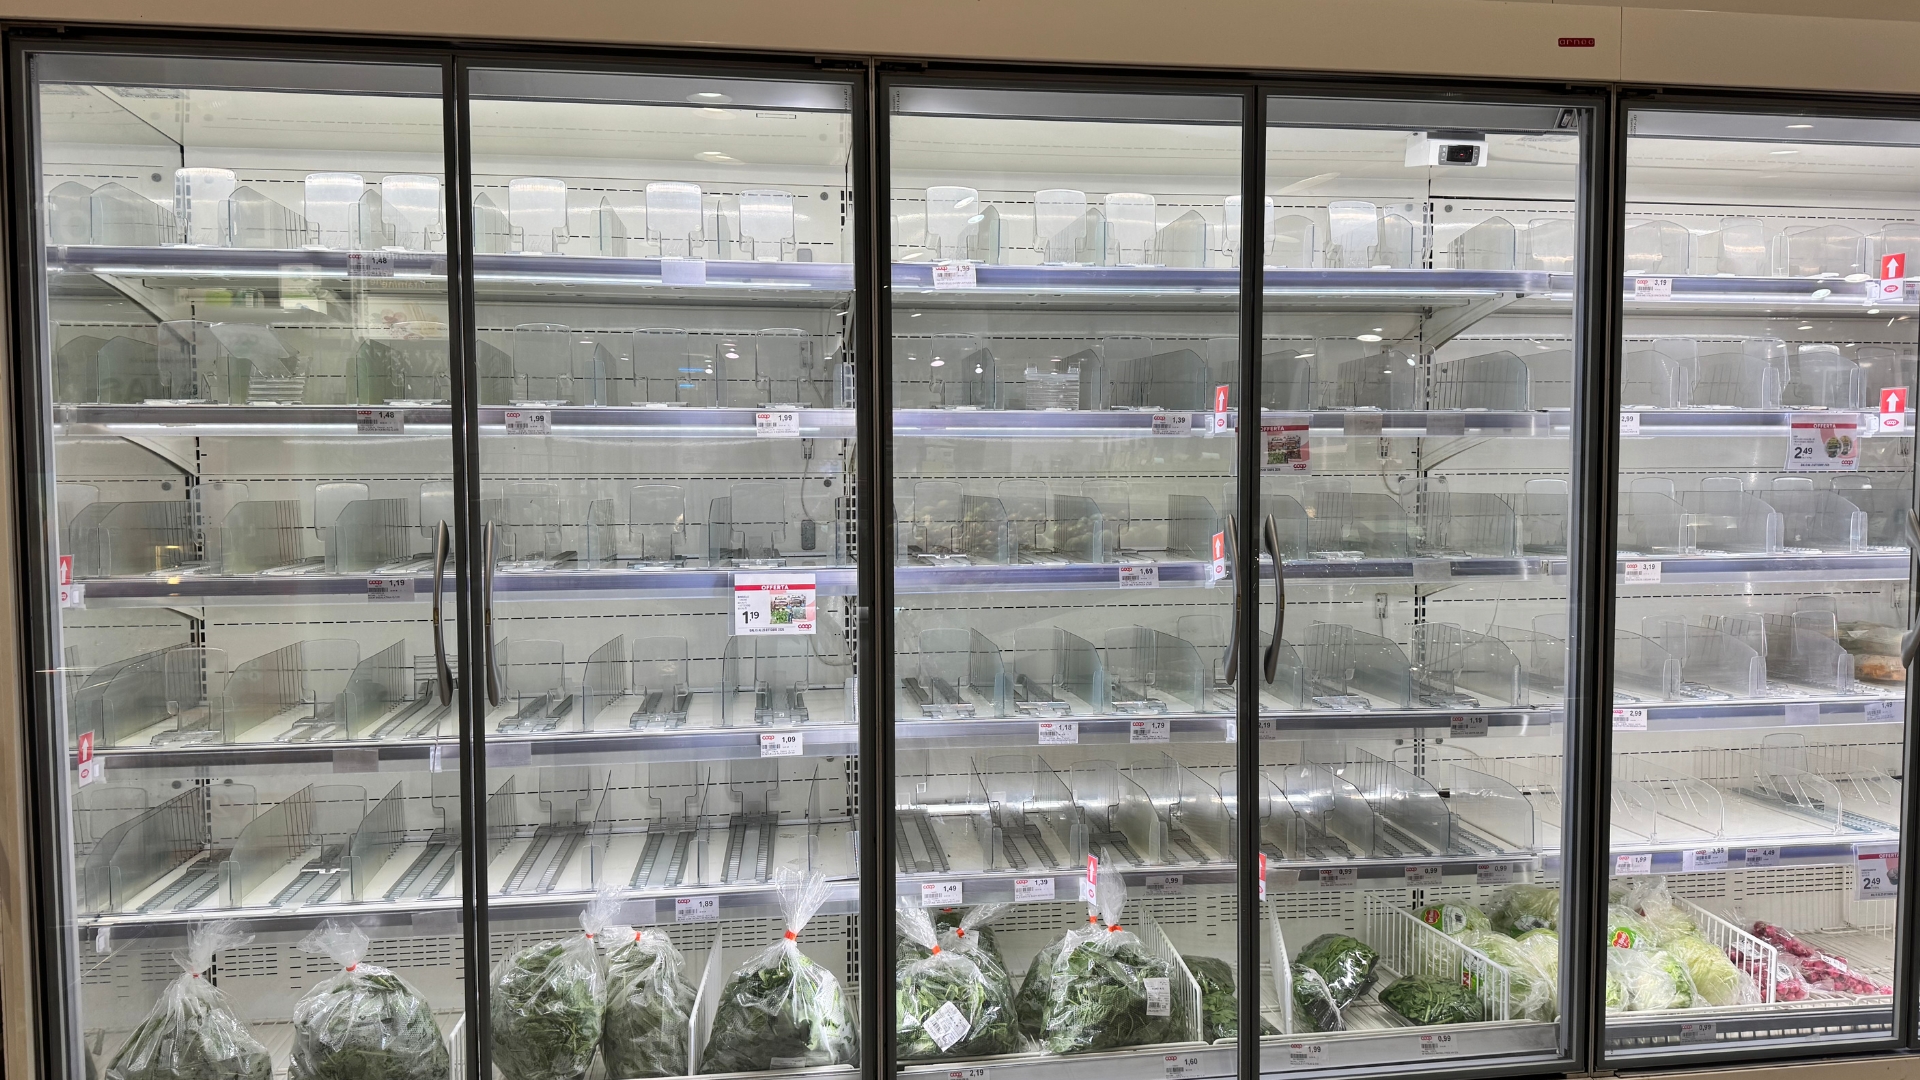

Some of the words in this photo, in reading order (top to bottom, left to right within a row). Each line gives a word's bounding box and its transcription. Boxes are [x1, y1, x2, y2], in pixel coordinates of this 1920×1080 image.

[1654, 279, 1667, 287] 3,19
[379, 411, 394, 419] 1,48
[778, 414, 793, 422] 1,99
[1643, 563, 1656, 571] 3,19
[782, 736, 796, 744] 1,09
[699, 900, 713, 908] 1,89
[1185, 1058, 1198, 1066] 1,60
[970, 1069, 984, 1078] 2,19
